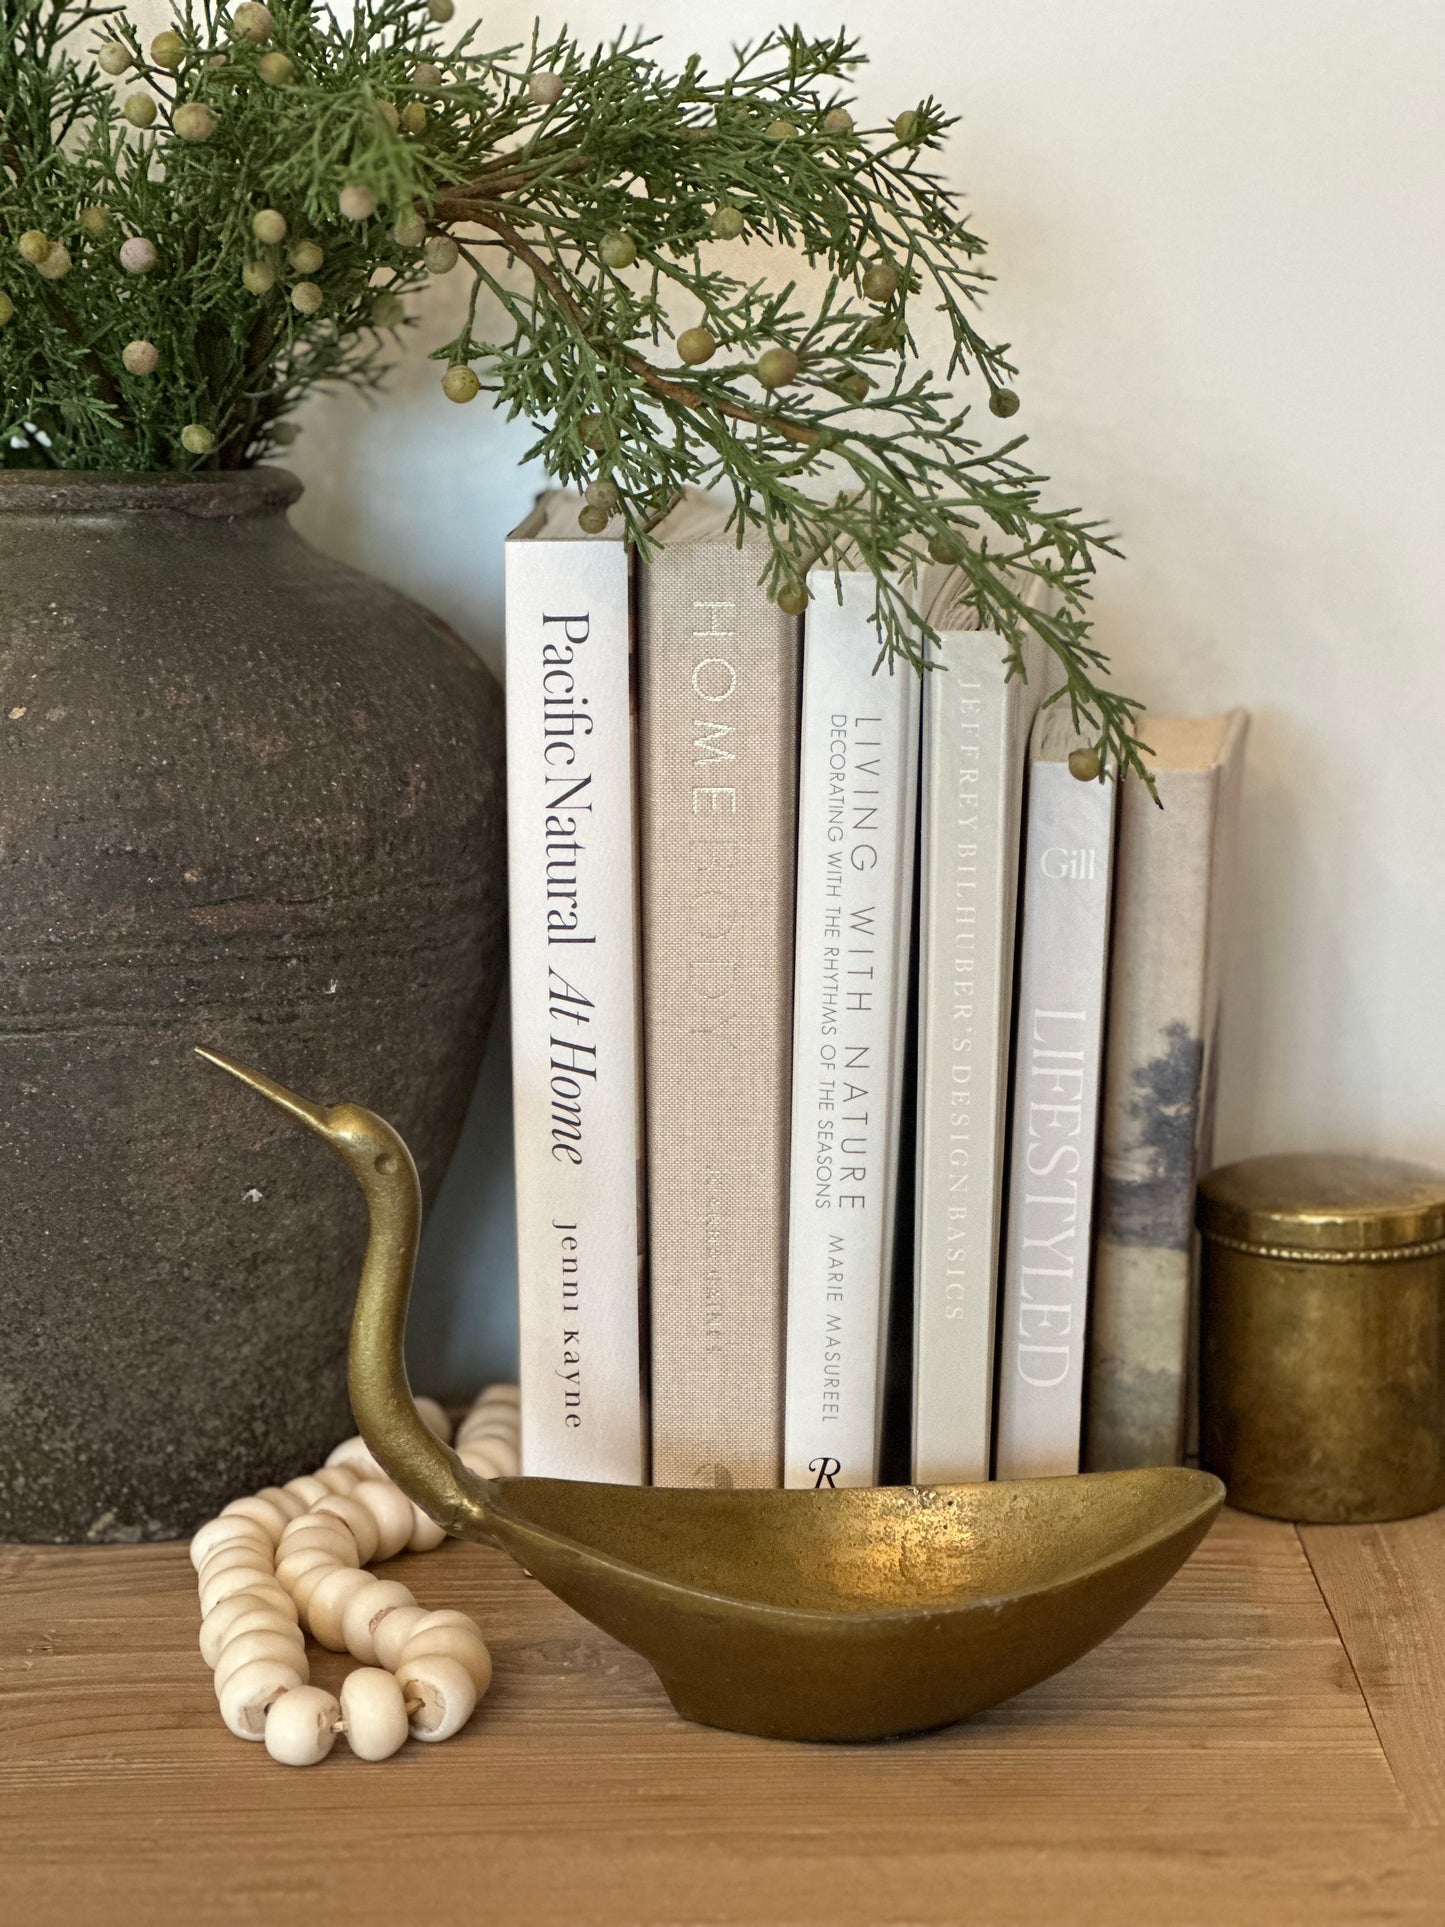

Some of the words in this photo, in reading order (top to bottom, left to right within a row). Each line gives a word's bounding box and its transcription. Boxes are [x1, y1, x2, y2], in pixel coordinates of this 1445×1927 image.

[543, 612, 593, 765] Pacific
[827, 714, 847, 843] DECORATING
[850, 717, 882, 871] LIVING
[957, 679, 981, 831] JEFFREY
[545, 773, 596, 945] Natural
[825, 851, 842, 897] WITH
[1040, 847, 1096, 880] Gill
[824, 906, 841, 938] THE
[846, 906, 876, 1011] WITH
[952, 844, 977, 1052] BILHUBER'S
[548, 965, 595, 1025] At
[821, 948, 840, 1036] RHYTHMS
[550, 1033, 597, 1165] Home
[818, 1080, 835, 1111] THE
[820, 1043, 837, 1071] OF
[815, 1119, 834, 1209] SEASONS
[838, 1046, 871, 1209] NATURE
[949, 1065, 972, 1193] DESIGN
[1017, 1008, 1087, 1387] LIFESTYLED
[826, 1233, 845, 1302] MARIE
[944, 1206, 968, 1321] BASICS
[822, 1313, 842, 1423] MASUREEL
[808, 1457, 841, 1489] R
